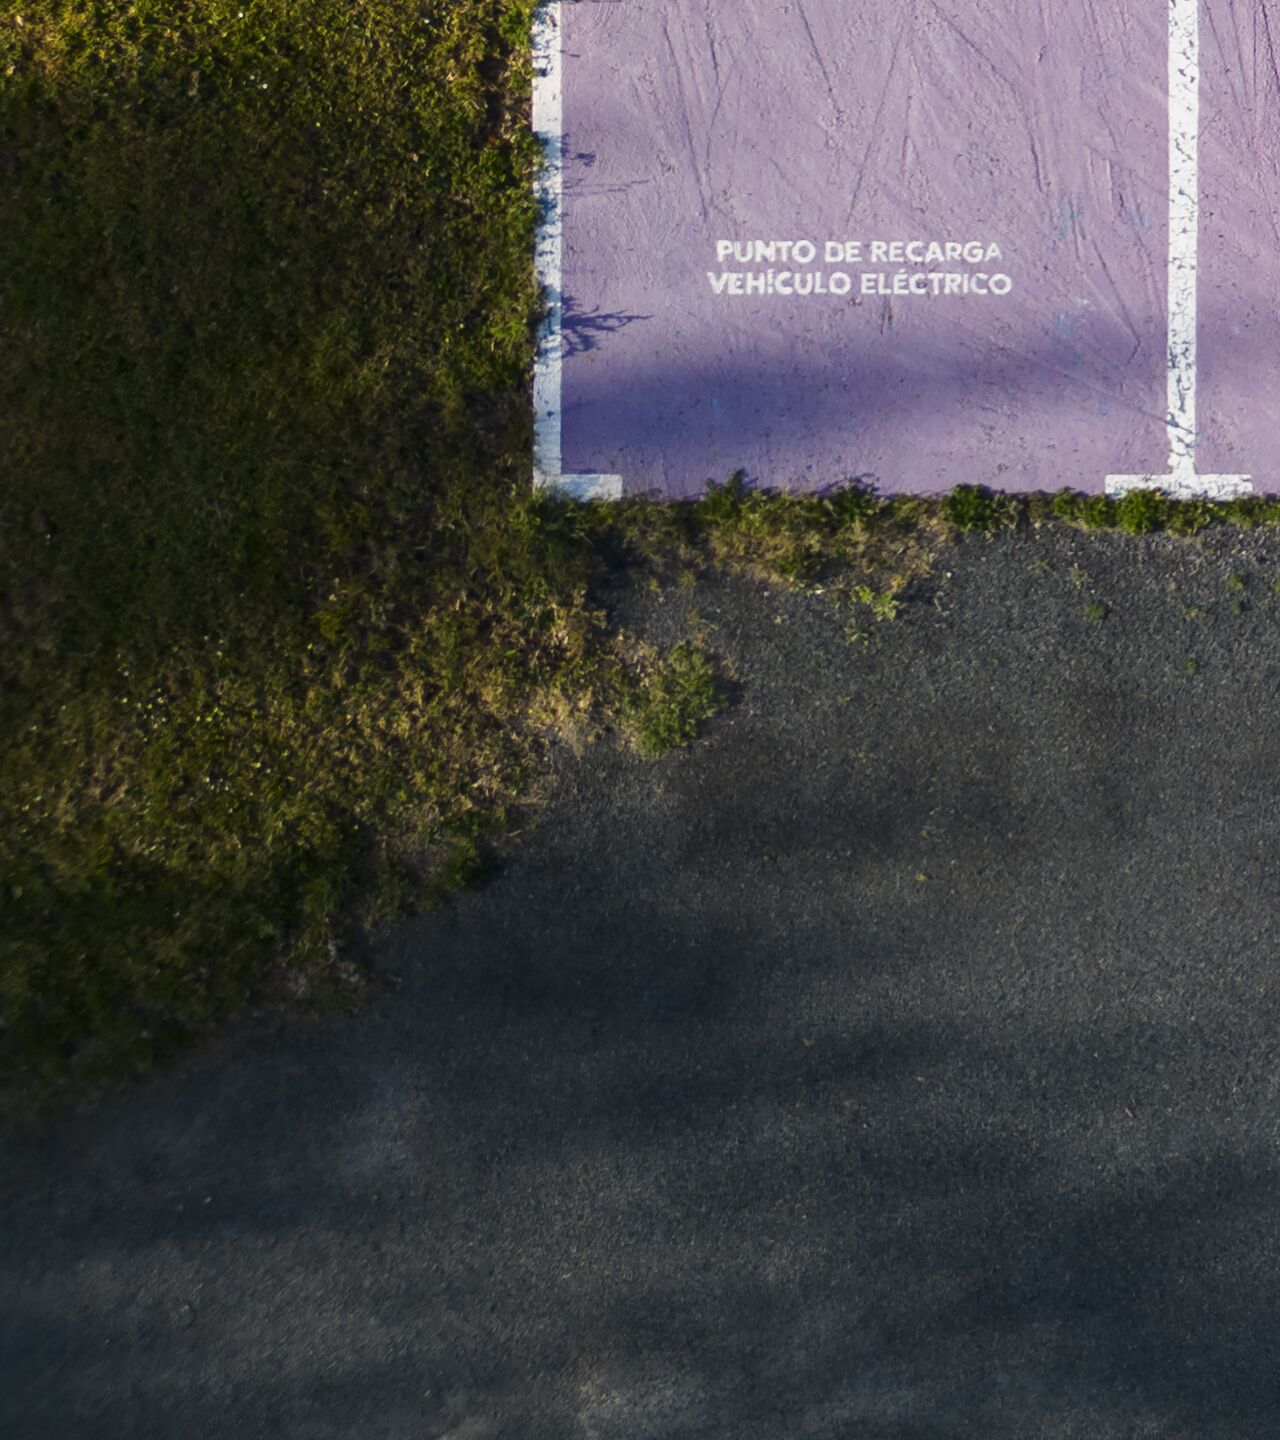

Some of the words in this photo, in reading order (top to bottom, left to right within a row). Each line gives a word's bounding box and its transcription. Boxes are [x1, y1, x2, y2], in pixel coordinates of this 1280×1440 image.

[716, 239, 816, 264] PUNTO
[825, 240, 862, 264] DE
[870, 240, 1003, 264] RECARGA
[706, 269, 852, 296] VEHÍCULO
[860, 268, 1013, 296] ELÉCTRICO
